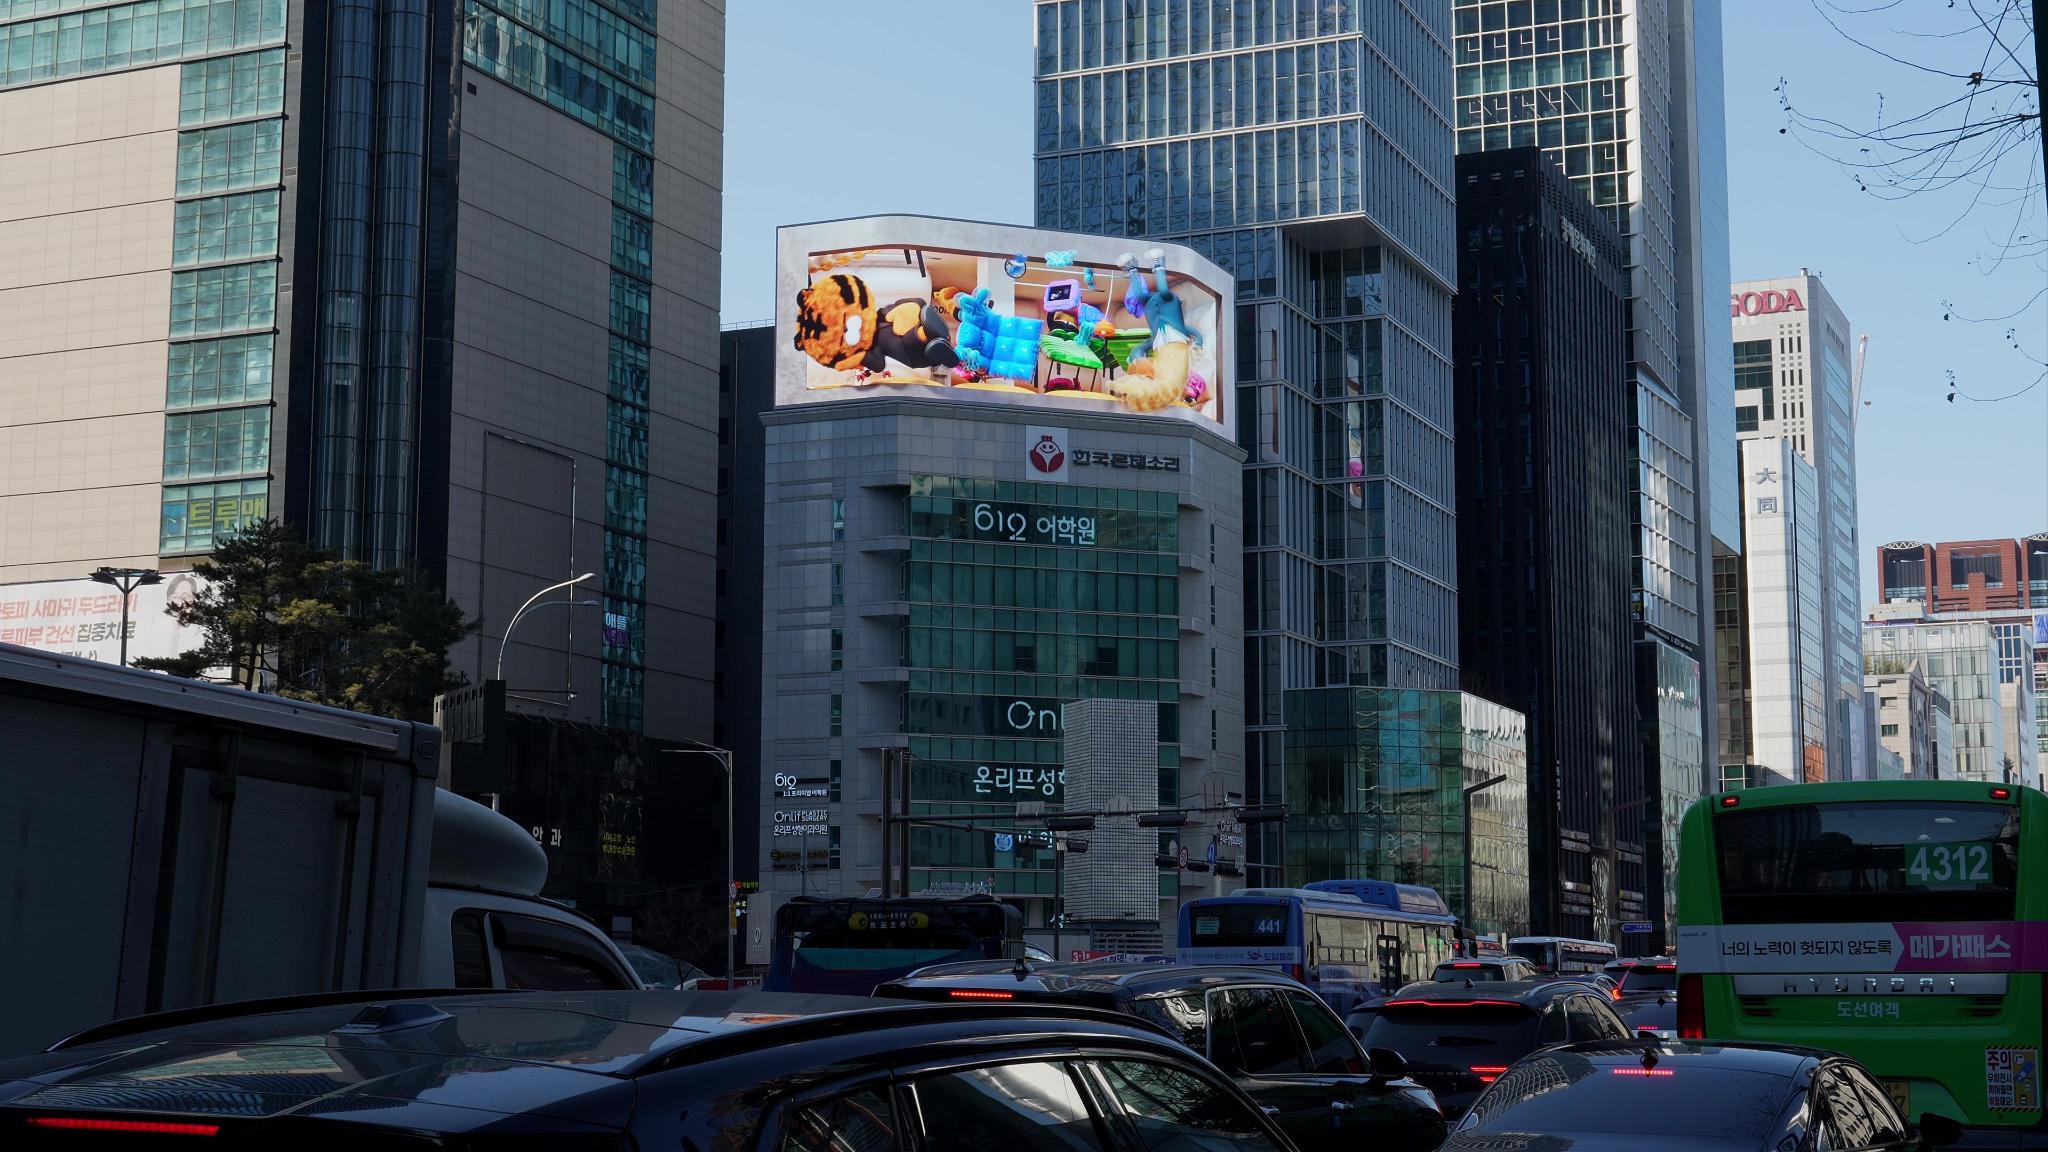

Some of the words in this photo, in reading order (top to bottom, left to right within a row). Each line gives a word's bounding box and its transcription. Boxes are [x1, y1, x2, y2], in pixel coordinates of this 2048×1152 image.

[974, 503, 1027, 541] 612
[1036, 515, 1095, 545] 어학원
[0, 600, 29, 620] 토피
[32, 597, 76, 618] 사마귀
[774, 773, 797, 790] 612
[1910, 845, 1989, 881] 4312
[1258, 919, 1280, 933] 441
[1722, 941, 1750, 957] 너의
[1753, 940, 1797, 957] 노력이
[1800, 940, 1844, 957] 헛되지
[1847, 939, 1893, 956] 않도록
[1909, 934, 2013, 960] 메가패스
[1837, 1001, 1900, 1019] 도선여객
[1987, 1051, 2012, 1071] 주의
